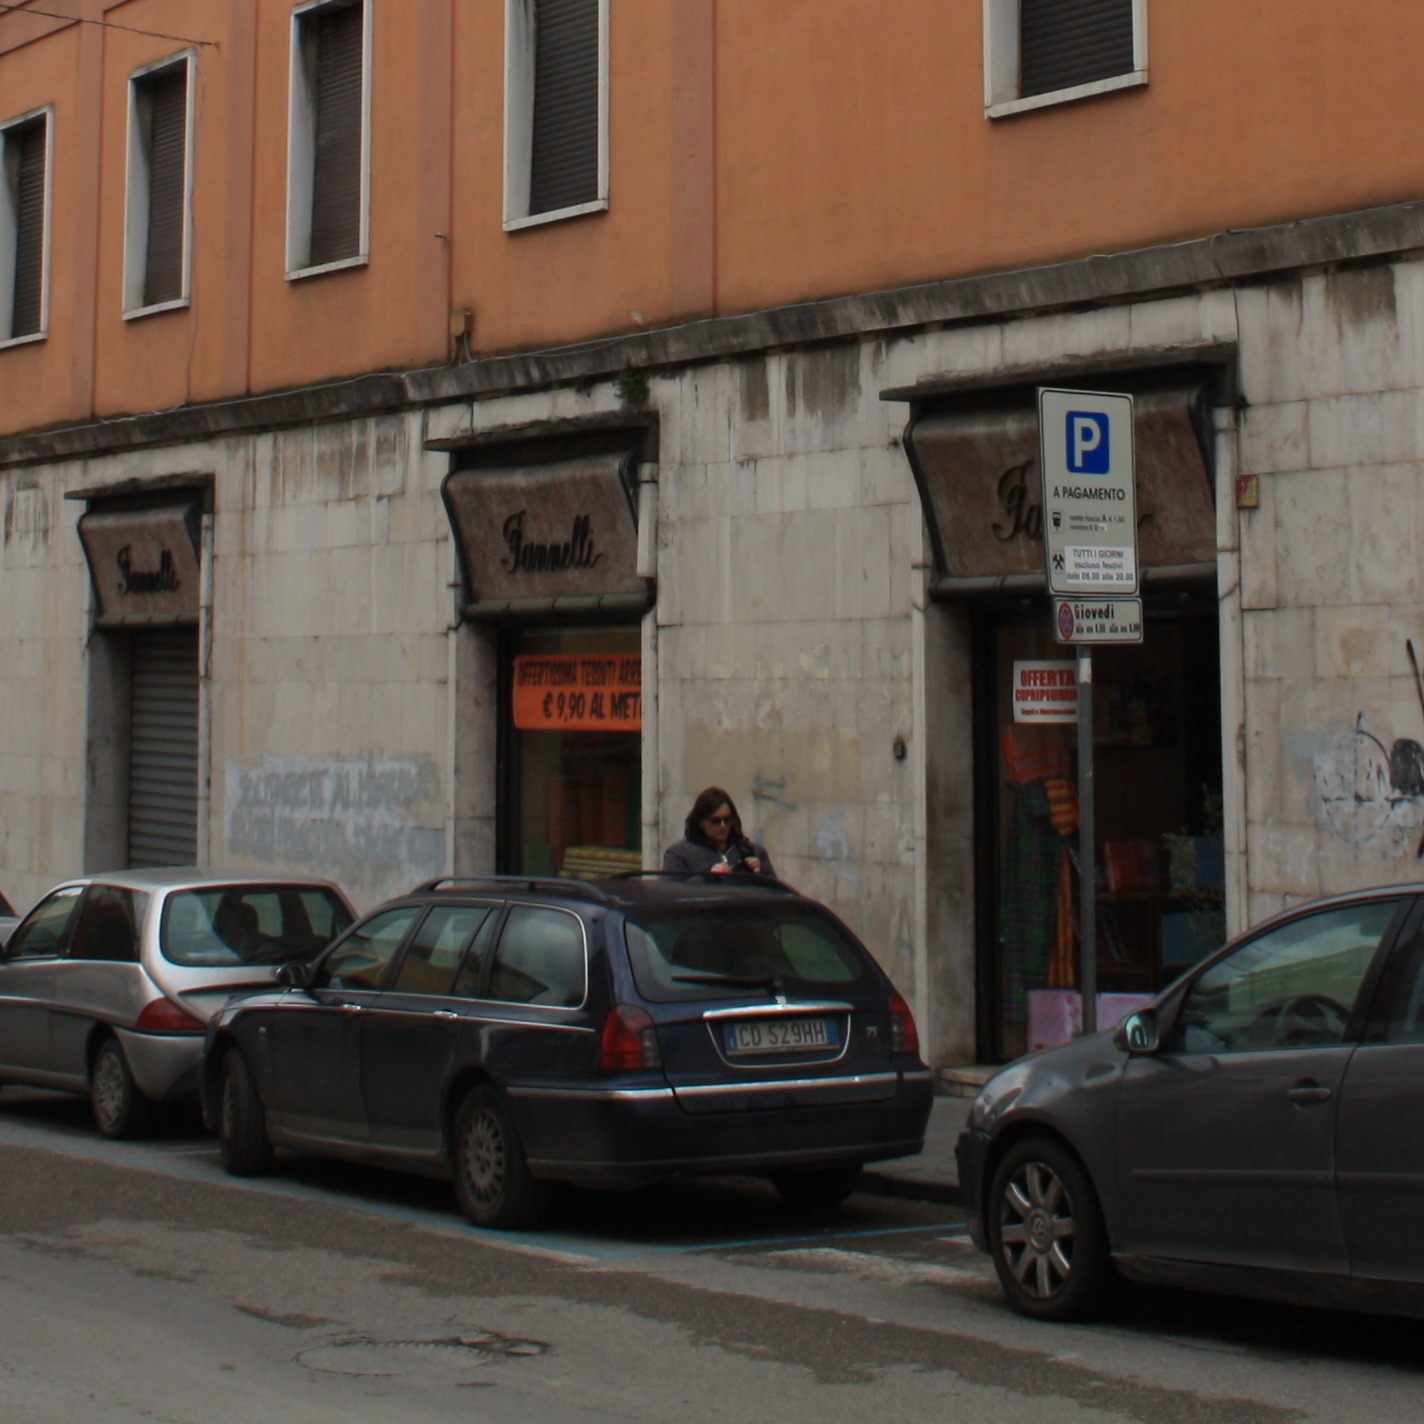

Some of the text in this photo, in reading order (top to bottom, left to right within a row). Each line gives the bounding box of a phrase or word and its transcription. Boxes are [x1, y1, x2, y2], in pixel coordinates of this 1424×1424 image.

[1073, 416, 1102, 468] P
[1053, 485, 1126, 501] A PAGAMENTO
[1073, 549, 1092, 558] TUTTI
[1098, 549, 1124, 559] GIORNI
[1074, 560, 1123, 570] escluso festivi
[1021, 669, 1076, 687] OFFERTA
[542, 691, 642, 723] € 9,90 AL MET
[738, 1020, 826, 1048] CD 529HH
